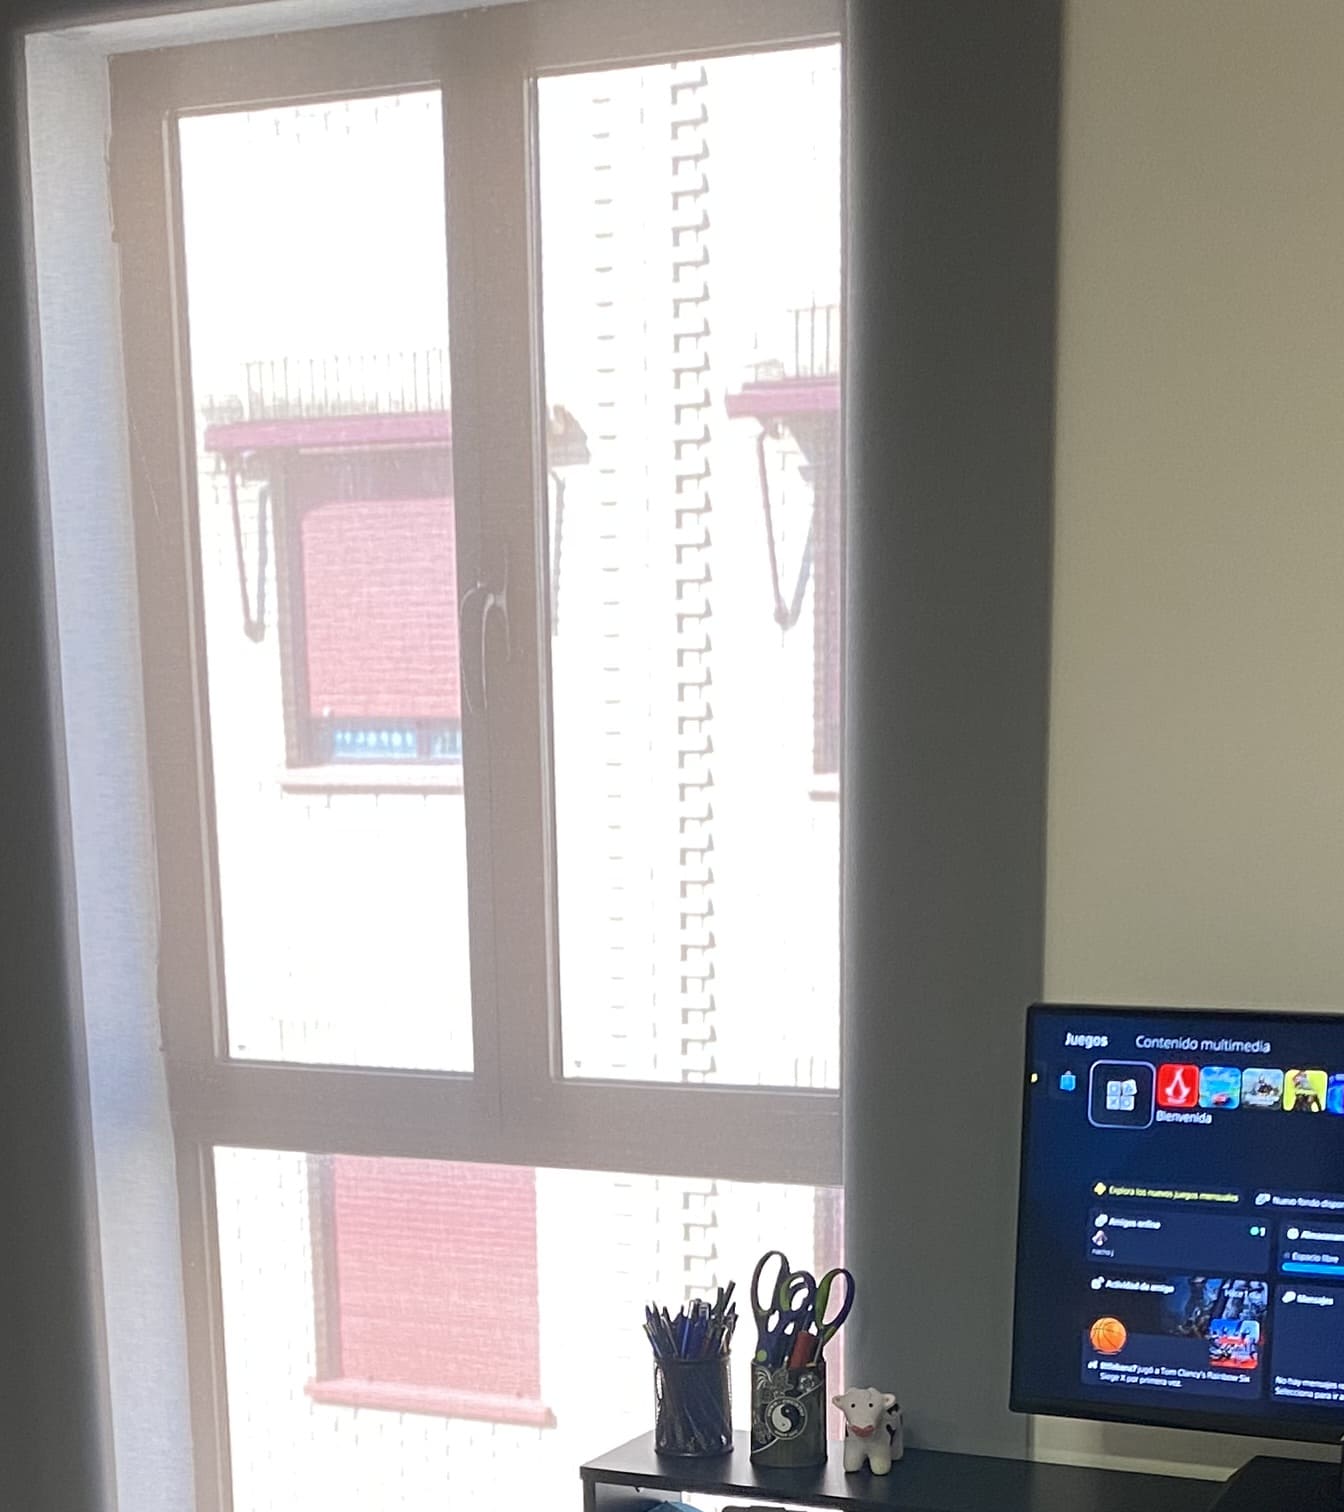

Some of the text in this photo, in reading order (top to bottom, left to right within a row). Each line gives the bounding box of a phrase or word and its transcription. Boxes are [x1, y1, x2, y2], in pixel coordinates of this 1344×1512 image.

[1065, 1032, 1109, 1049] Juegos
[1135, 1035, 1271, 1053] Contenido multimedia
[1156, 1110, 1212, 1124] Bienvenida
[1109, 1186, 1135, 1196] Explora
[1173, 1191, 1198, 1200] juegos
[1108, 1217, 1136, 1228] Amigos
[1292, 1251, 1339, 1263] Espacio libre
[1105, 1280, 1140, 1290] Actividad
[1100, 1372, 1119, 1382] Siege
[1139, 1377, 1167, 1386] primera
[1160, 1367, 1177, 1376] Tom
[1177, 1368, 1206, 1379] Clancy's
[1275, 1376, 1287, 1385] No
[1287, 1377, 1301, 1387] hay
[1302, 1380, 1337, 1390] mensajes
[1275, 1386, 1313, 1397] Selecciona
[1314, 1391, 1331, 1400] para
